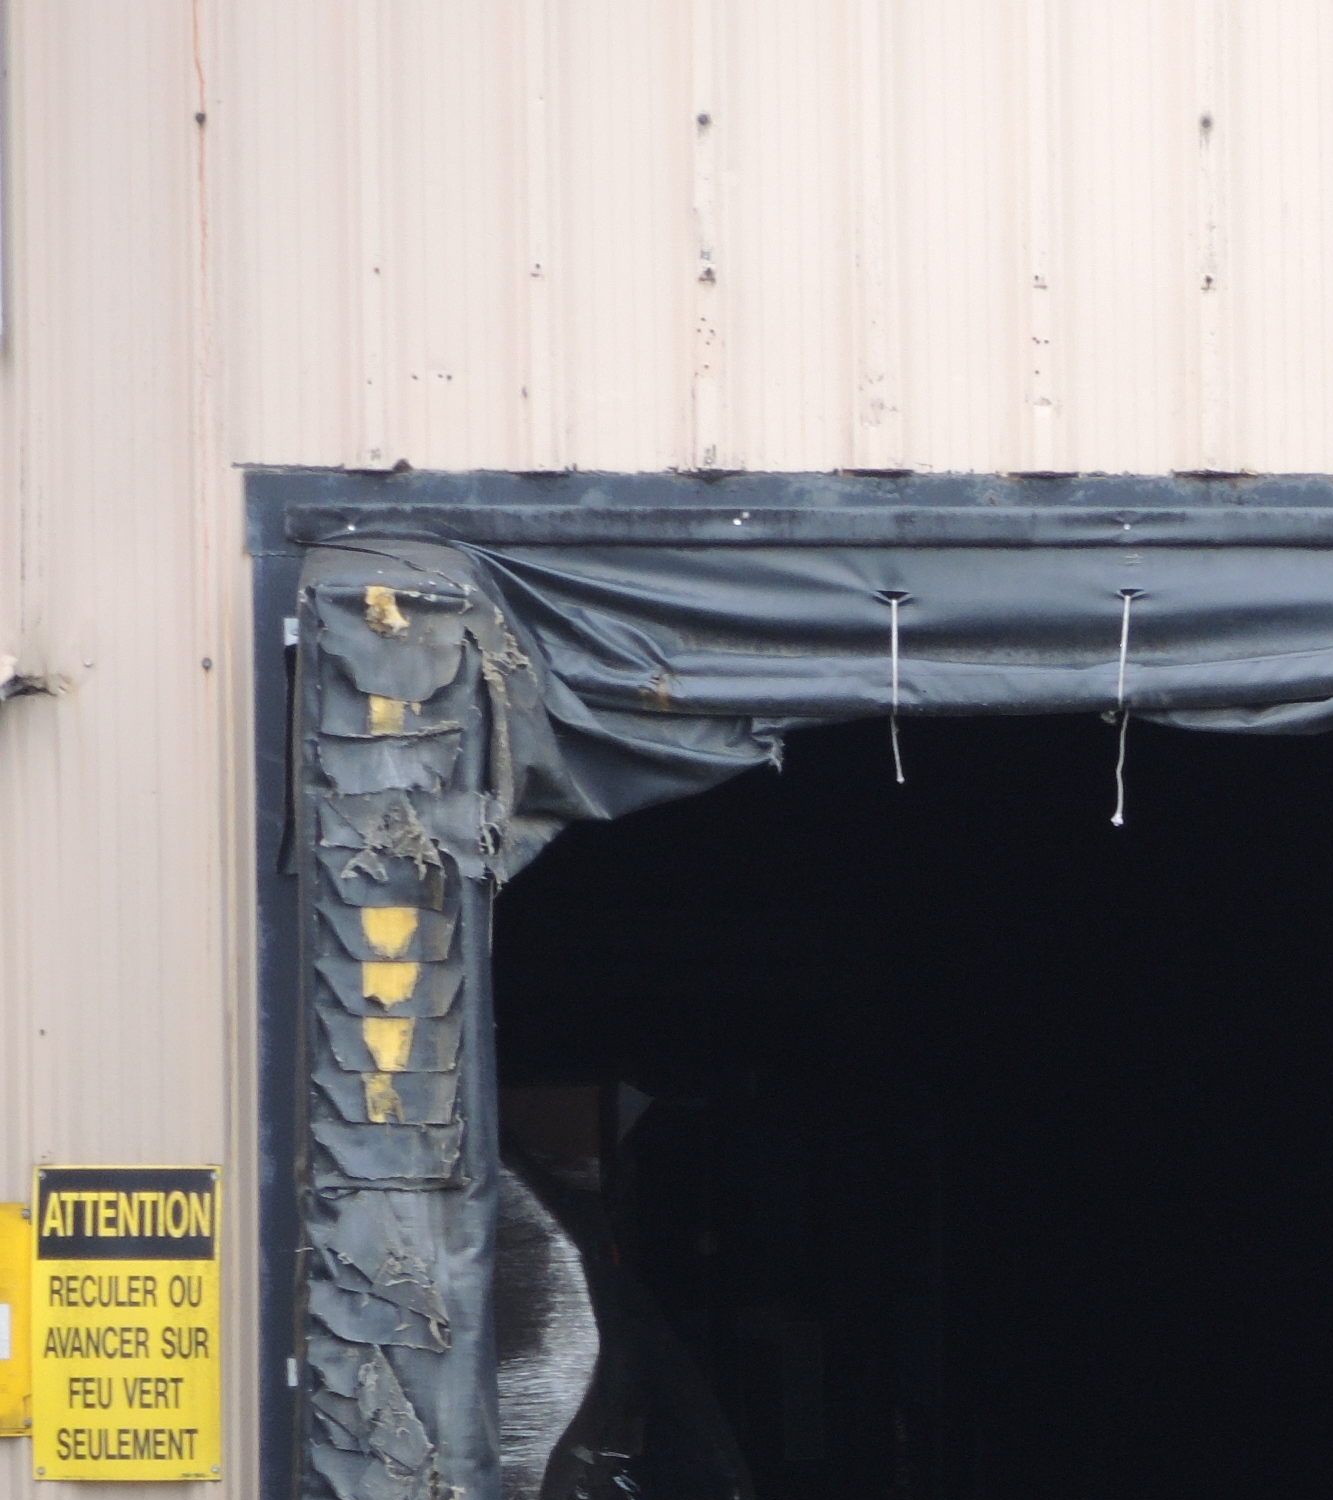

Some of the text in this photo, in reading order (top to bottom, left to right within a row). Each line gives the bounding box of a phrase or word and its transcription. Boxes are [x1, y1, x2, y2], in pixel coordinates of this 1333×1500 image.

[42, 1190, 212, 1239] ATTENTION
[49, 1274, 203, 1309] RECULER OU
[43, 1325, 210, 1360] AVANCER SUR
[68, 1376, 184, 1410] FEU VERT
[56, 1427, 199, 1461] SEULEMENT
